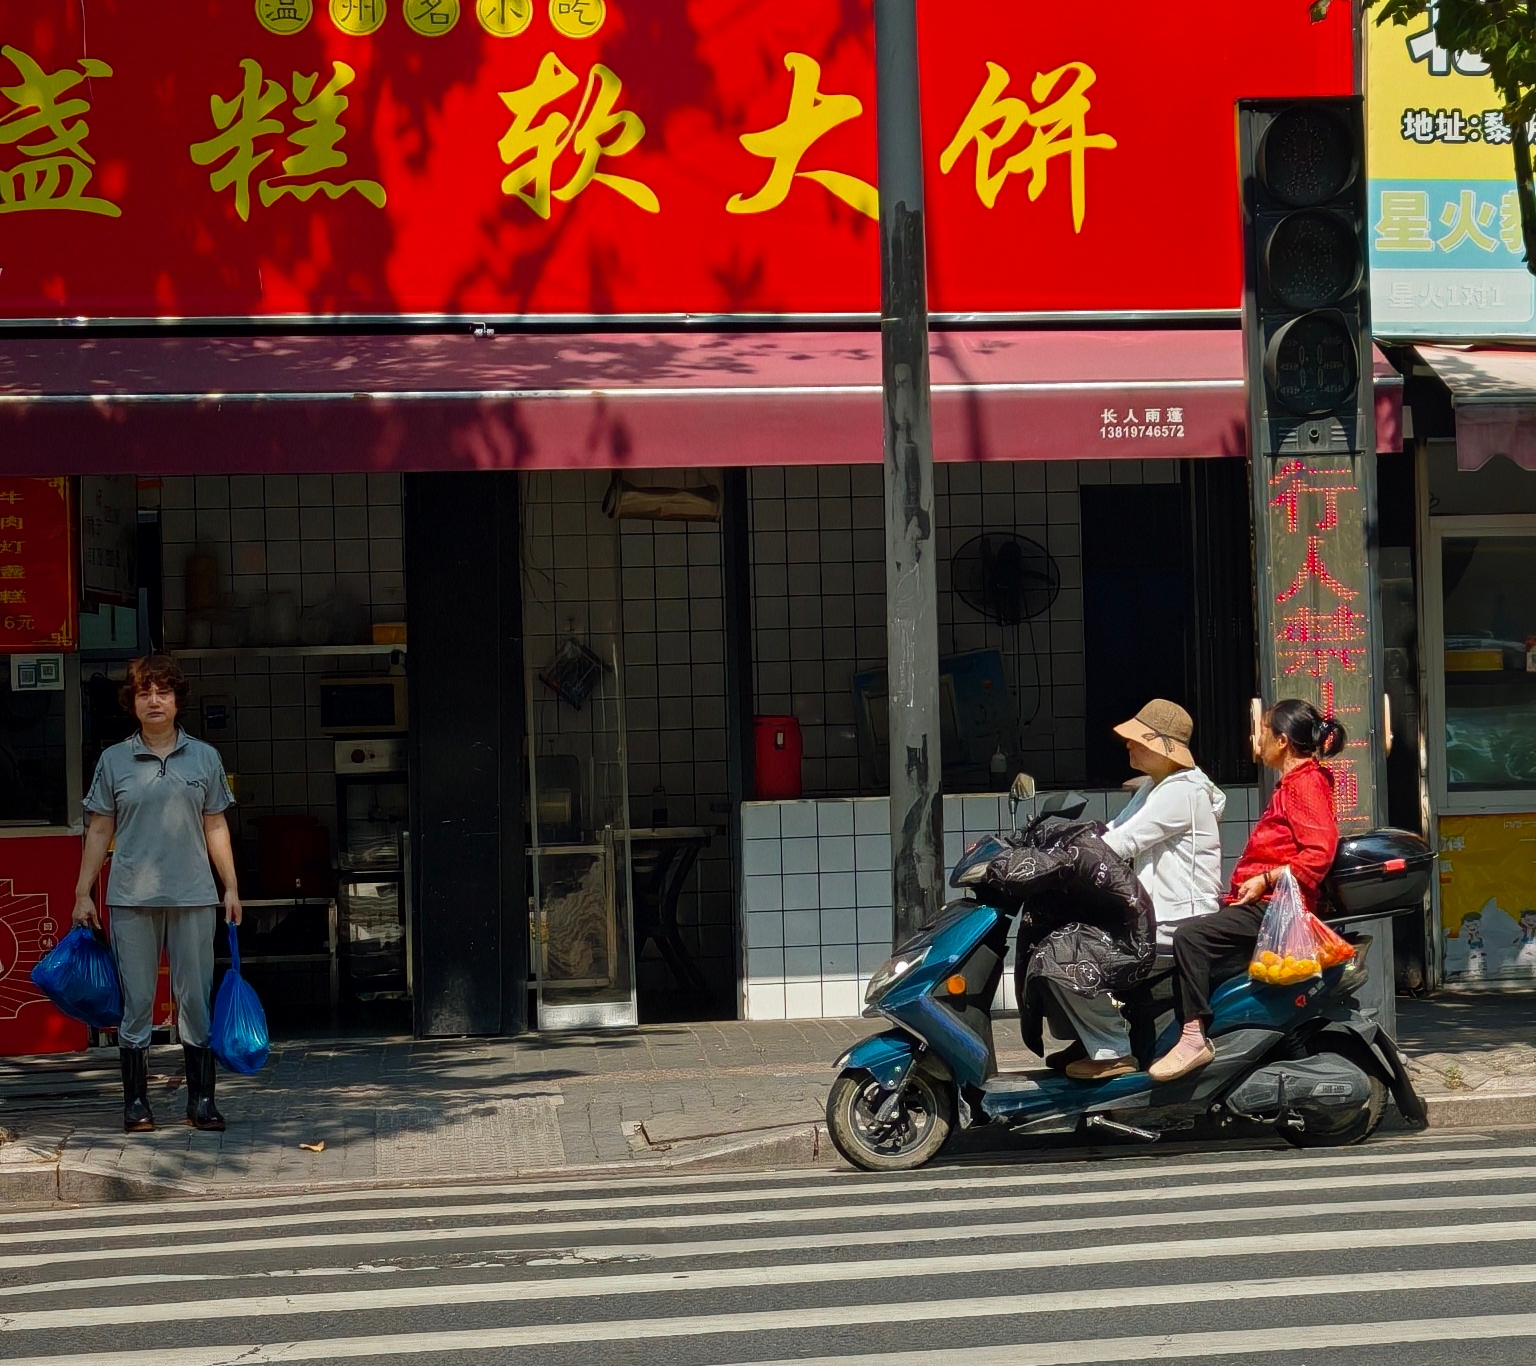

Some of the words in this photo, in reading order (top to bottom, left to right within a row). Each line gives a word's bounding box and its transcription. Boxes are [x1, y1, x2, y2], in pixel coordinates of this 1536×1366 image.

[1100, 406, 1184, 425] 长人雨蓬
[1099, 424, 1185, 440] 13819746572
